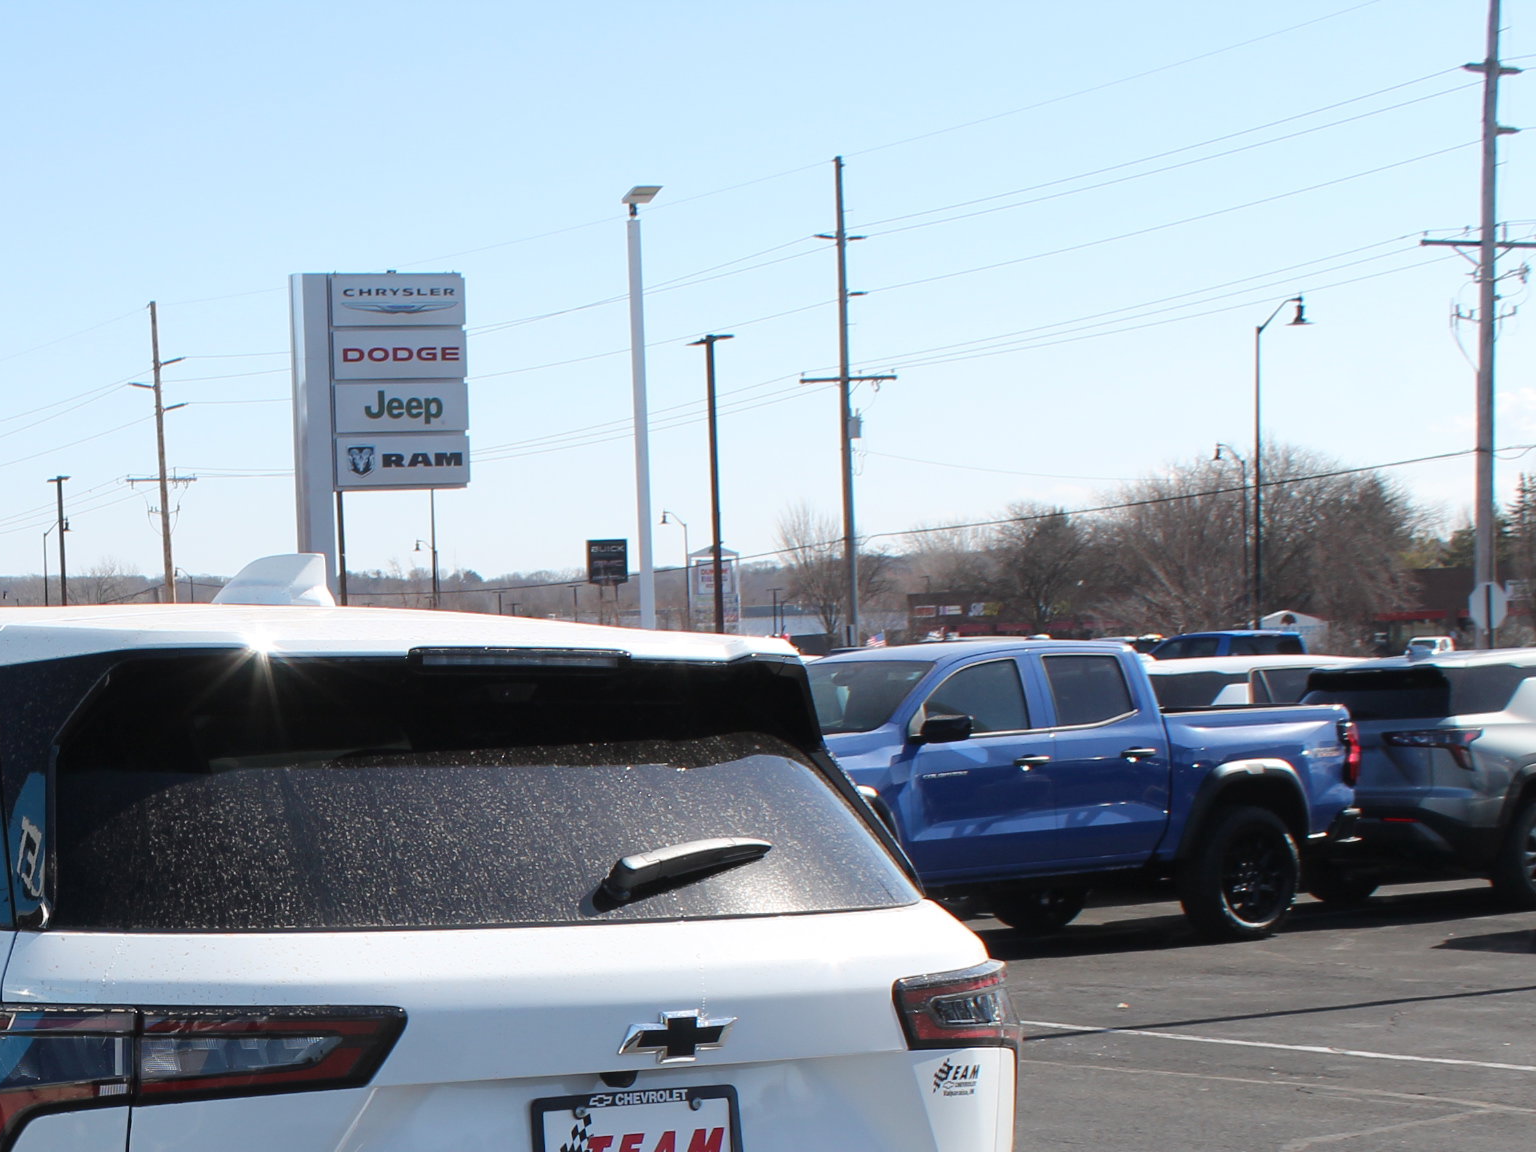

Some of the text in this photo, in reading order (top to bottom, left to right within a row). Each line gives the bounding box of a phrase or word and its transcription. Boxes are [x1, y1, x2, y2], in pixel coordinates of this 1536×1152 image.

[342, 287, 456, 298] CHRYSLER
[342, 346, 461, 363] DODGE
[364, 390, 444, 425] Jeep
[381, 451, 464, 468] RAM
[590, 545, 625, 553] BUICK
[615, 1088, 688, 1106] CHEVROLET
